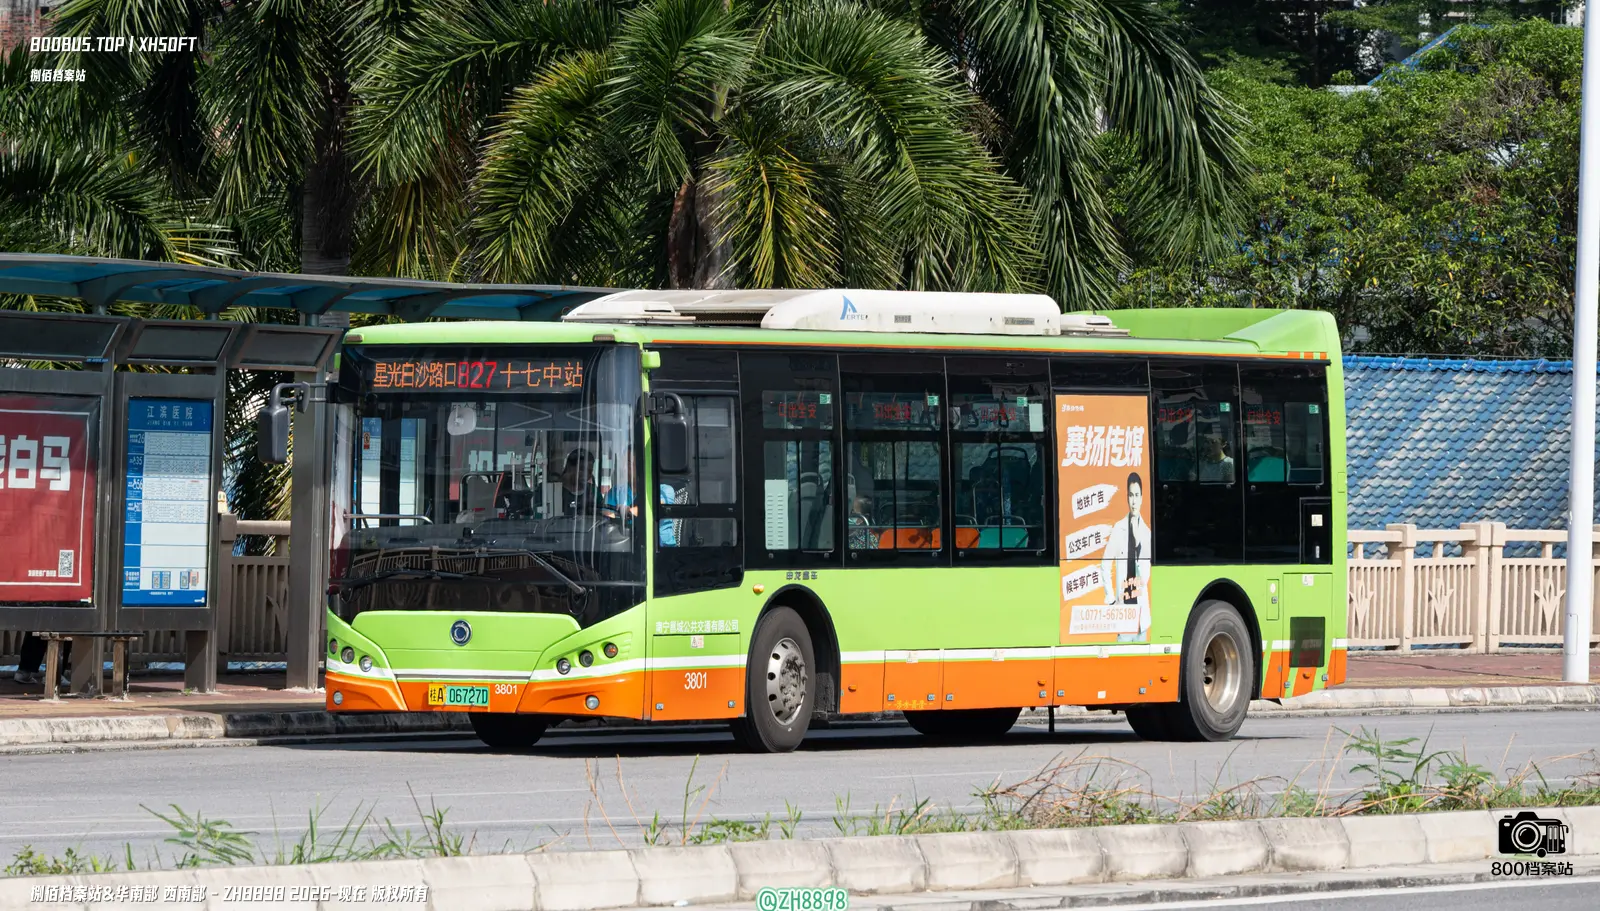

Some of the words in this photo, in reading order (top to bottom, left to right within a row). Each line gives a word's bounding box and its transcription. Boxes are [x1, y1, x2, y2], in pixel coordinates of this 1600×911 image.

[374, 362, 456, 388] 星光白沙路口
[500, 361, 583, 388] 十七中站
[147, 405, 193, 420] 江滨医院
[1061, 425, 1145, 467] 赛扬传媒
[0, 435, 70, 491] 白马
[1077, 490, 1104, 510] 地铁广告
[1069, 531, 1101, 554] 公交车广告
[1066, 571, 1099, 594] 候车亭广告
[1085, 608, 1136, 621] 0771-5675180
[494, 684, 518, 695] 3801
[684, 671, 707, 690] 3801
[449, 687, 488, 704] 06727D
